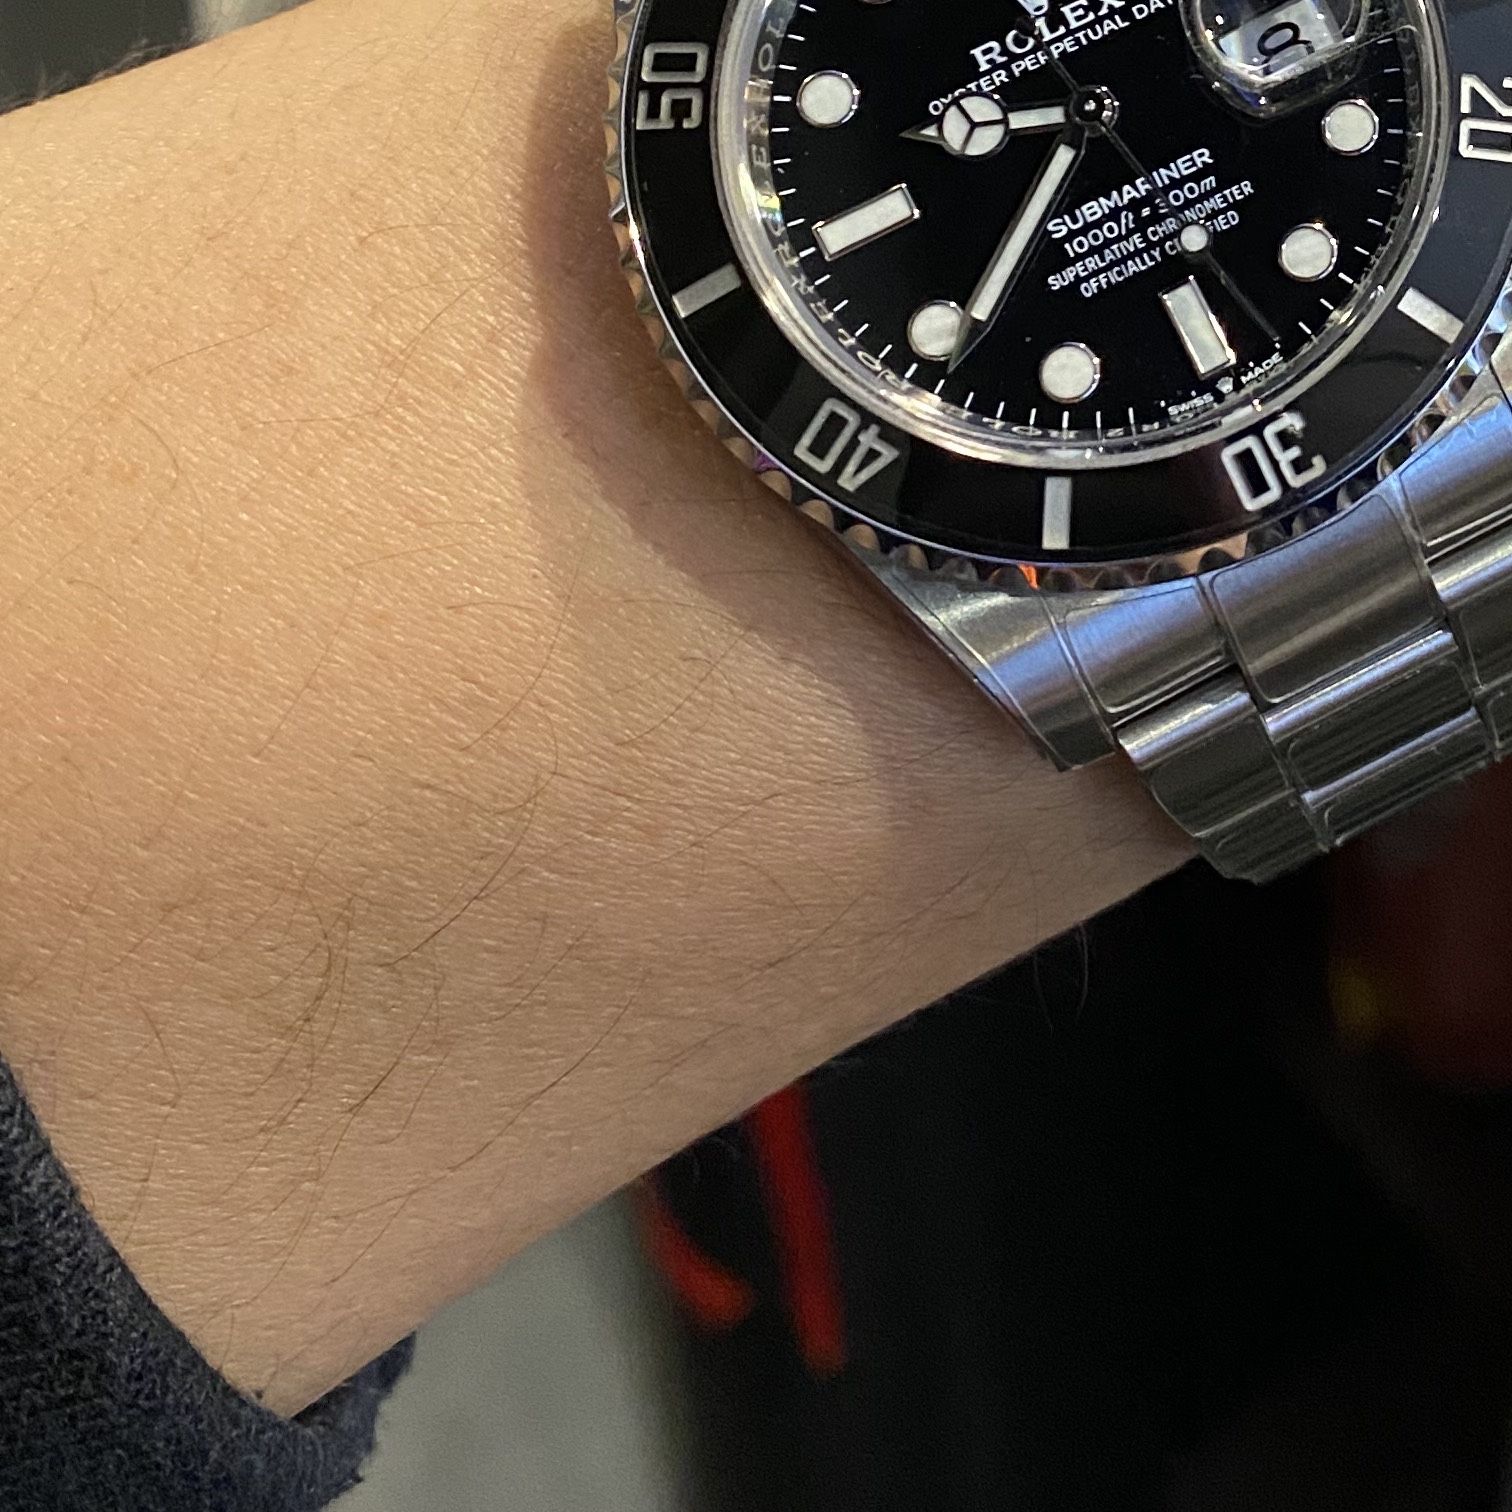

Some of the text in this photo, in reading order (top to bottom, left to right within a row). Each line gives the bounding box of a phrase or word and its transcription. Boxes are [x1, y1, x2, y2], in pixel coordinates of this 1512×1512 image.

[637, 40, 710, 131] 50
[1046, 147, 1215, 239] SUBMARINER
[1047, 232, 1148, 291] SUPERLATIVE
[1079, 245, 1161, 299] OFFICIALLY
[1239, 351, 1284, 385] MADE
[793, 397, 901, 493] 40
[1220, 411, 1328, 512] 30
